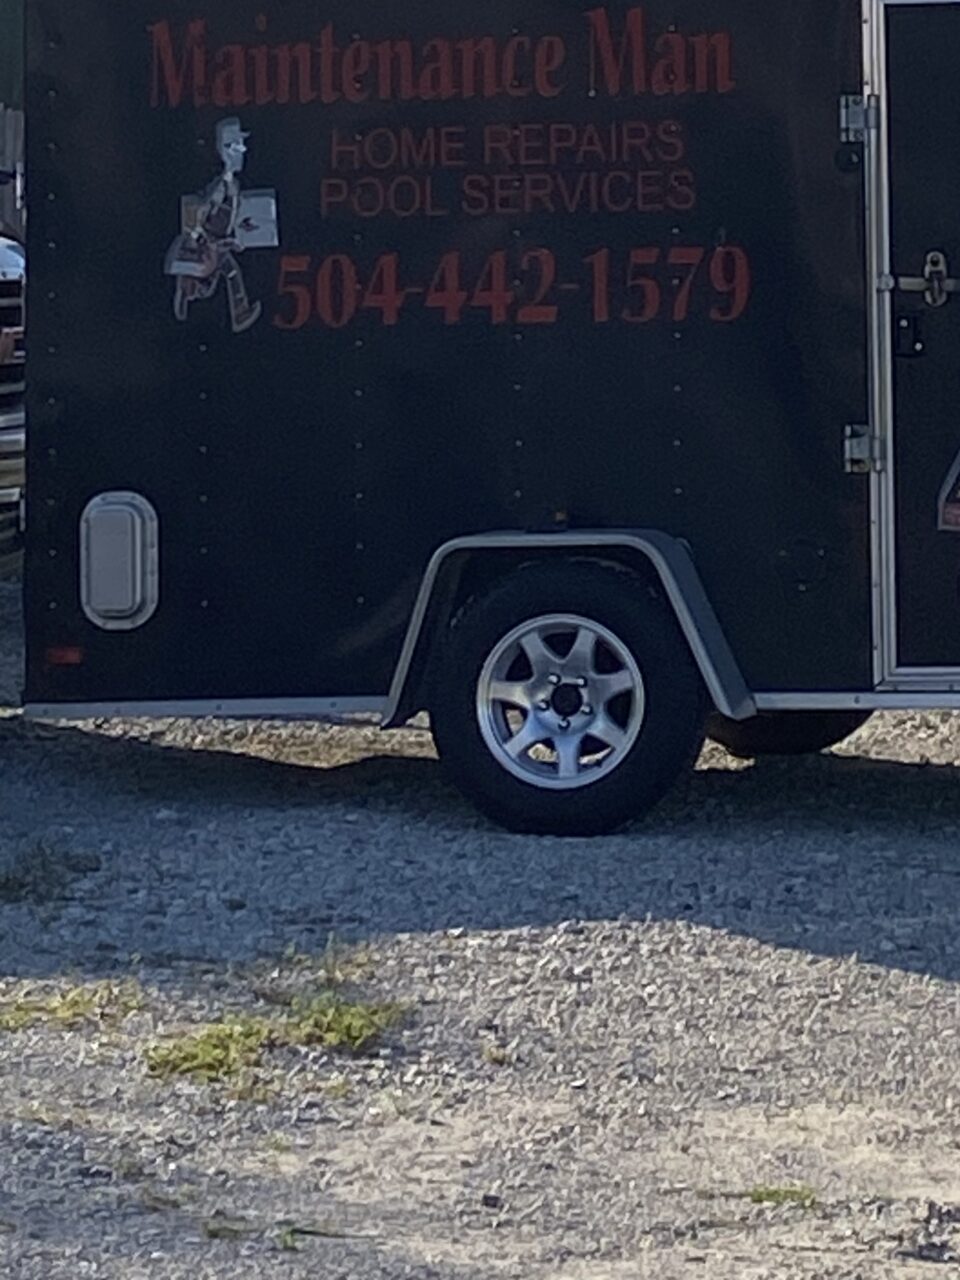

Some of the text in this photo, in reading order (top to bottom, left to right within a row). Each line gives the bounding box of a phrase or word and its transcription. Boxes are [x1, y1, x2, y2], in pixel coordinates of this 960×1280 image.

[146, 6, 737, 109] Maintenance Man
[331, 120, 686, 170] HOME REPAIRS
[320, 168, 695, 219] POOL SERVICES
[271, 245, 753, 329] 504-442-1579
